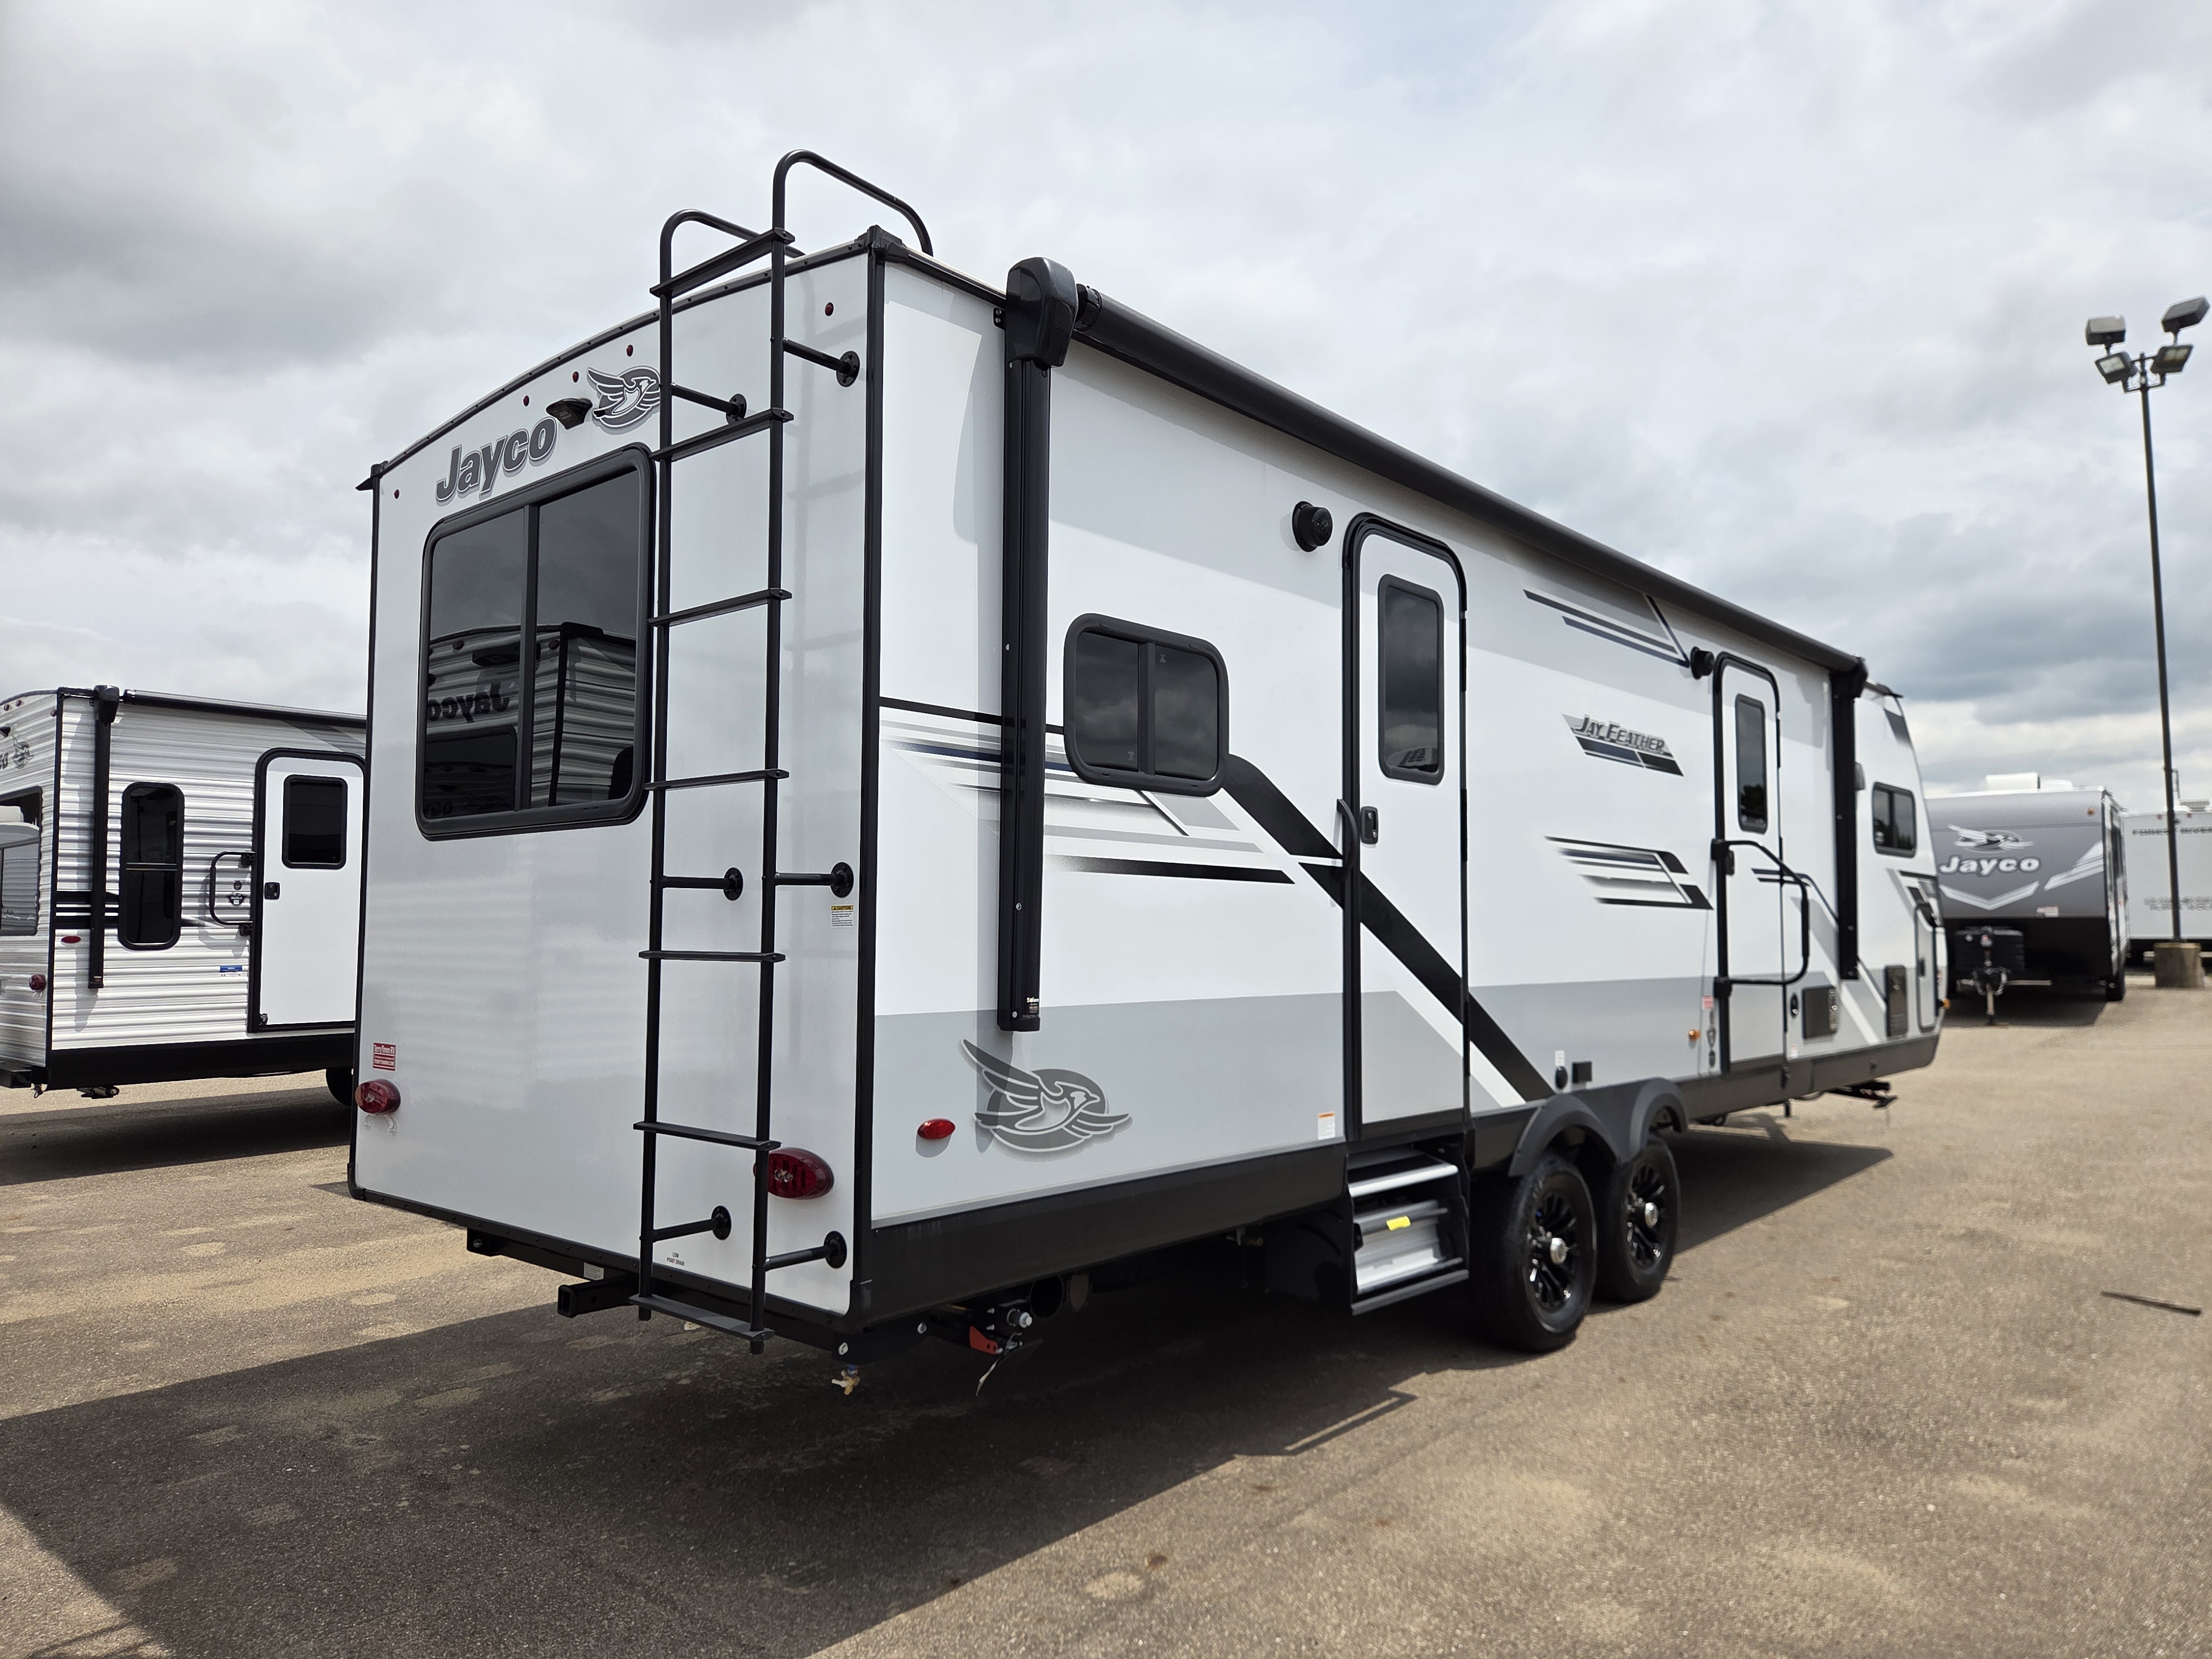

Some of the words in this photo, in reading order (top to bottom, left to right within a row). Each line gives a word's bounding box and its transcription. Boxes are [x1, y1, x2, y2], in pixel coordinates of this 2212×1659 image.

[436, 416, 557, 502] Jayco
[1574, 715, 1604, 737] JAY
[1605, 721, 1665, 753] FEATHER
[1939, 855, 2040, 876] Jayco
